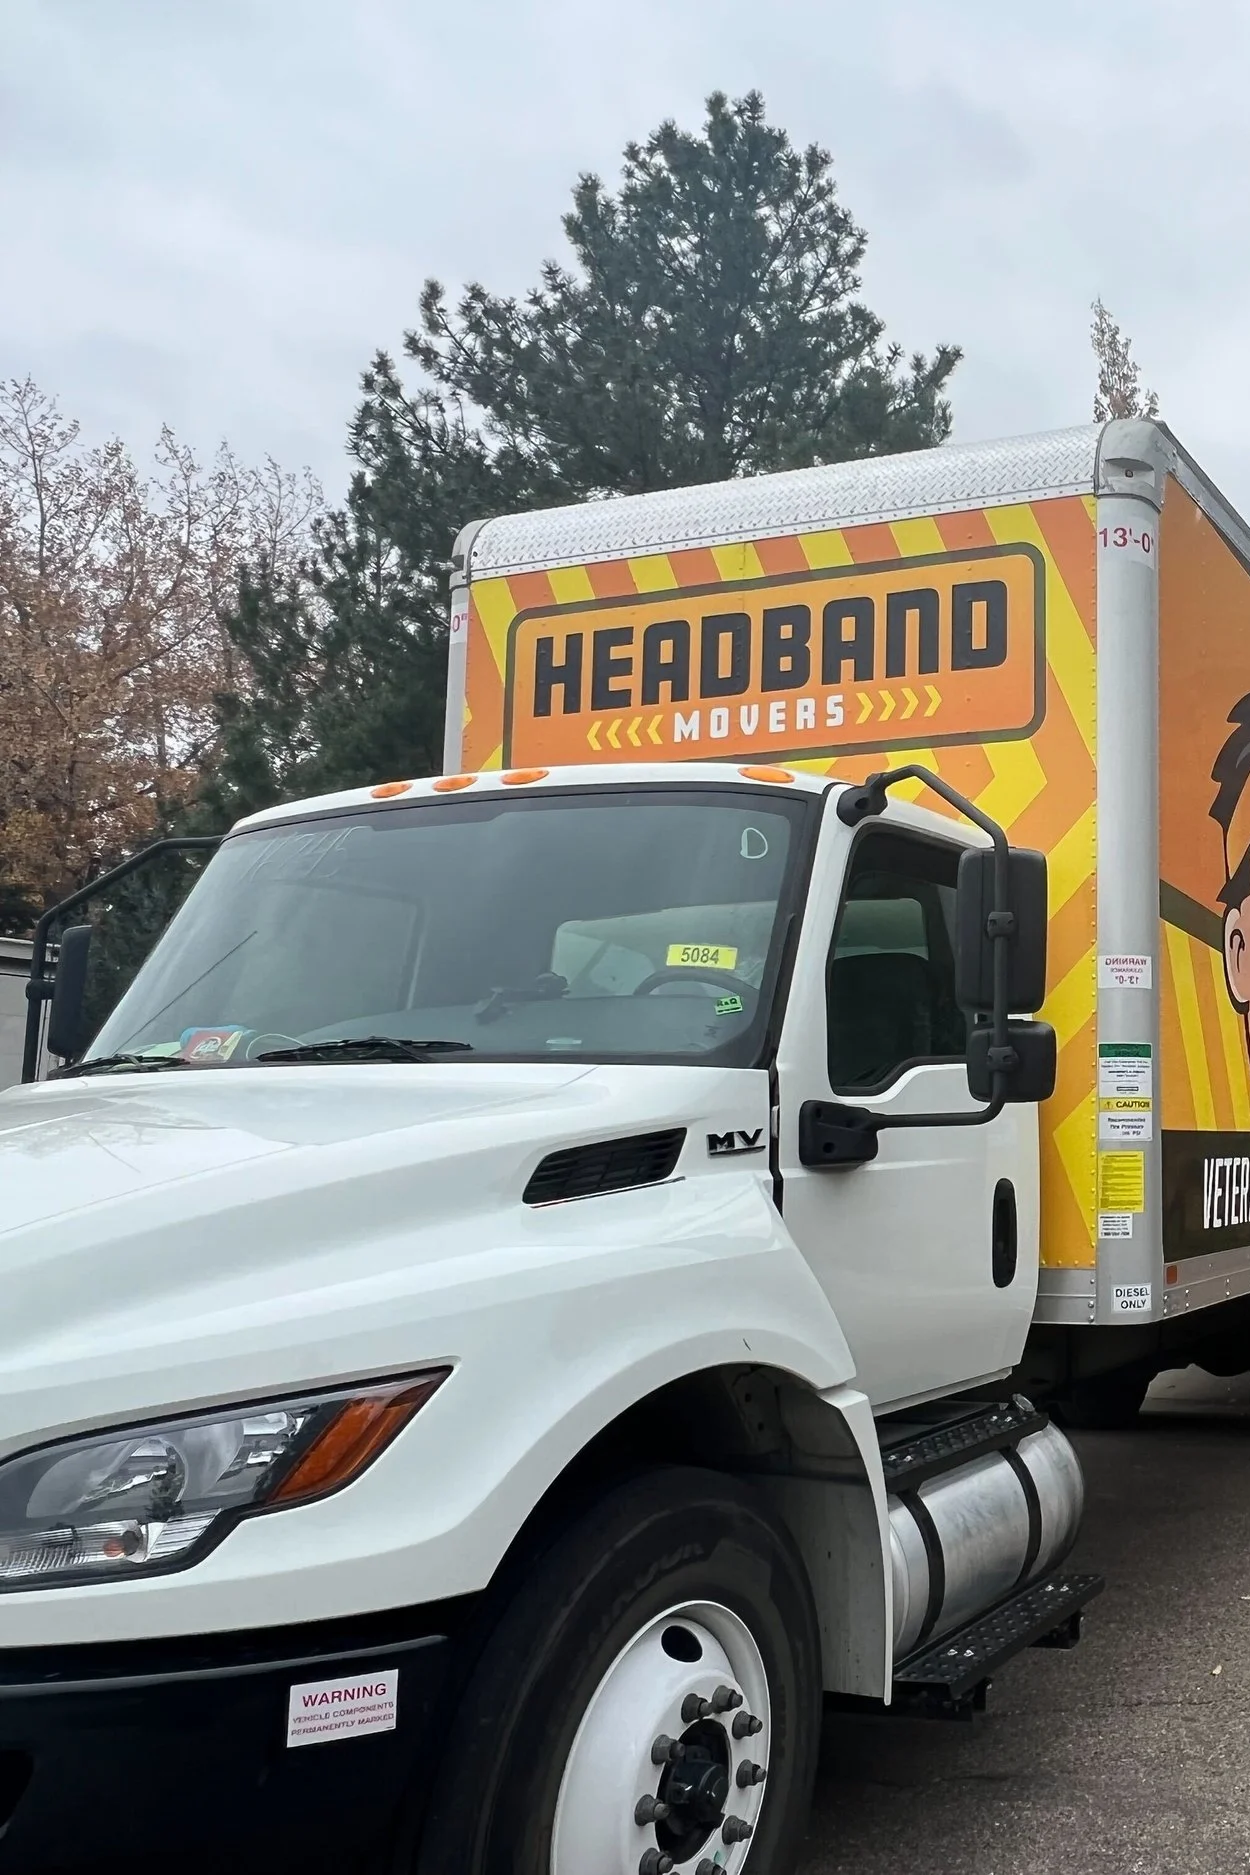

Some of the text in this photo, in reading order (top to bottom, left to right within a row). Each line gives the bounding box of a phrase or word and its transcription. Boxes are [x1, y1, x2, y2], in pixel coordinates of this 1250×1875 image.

[532, 579, 1008, 719] HEADBAND
[673, 694, 845, 743] MOVERS
[680, 947, 720, 965] 5084
[706, 1128, 764, 1151] MV
[1115, 1287, 1150, 1298] DIESEL
[1120, 1299, 1147, 1309] ONLY
[302, 1683, 387, 1708] WARNING
